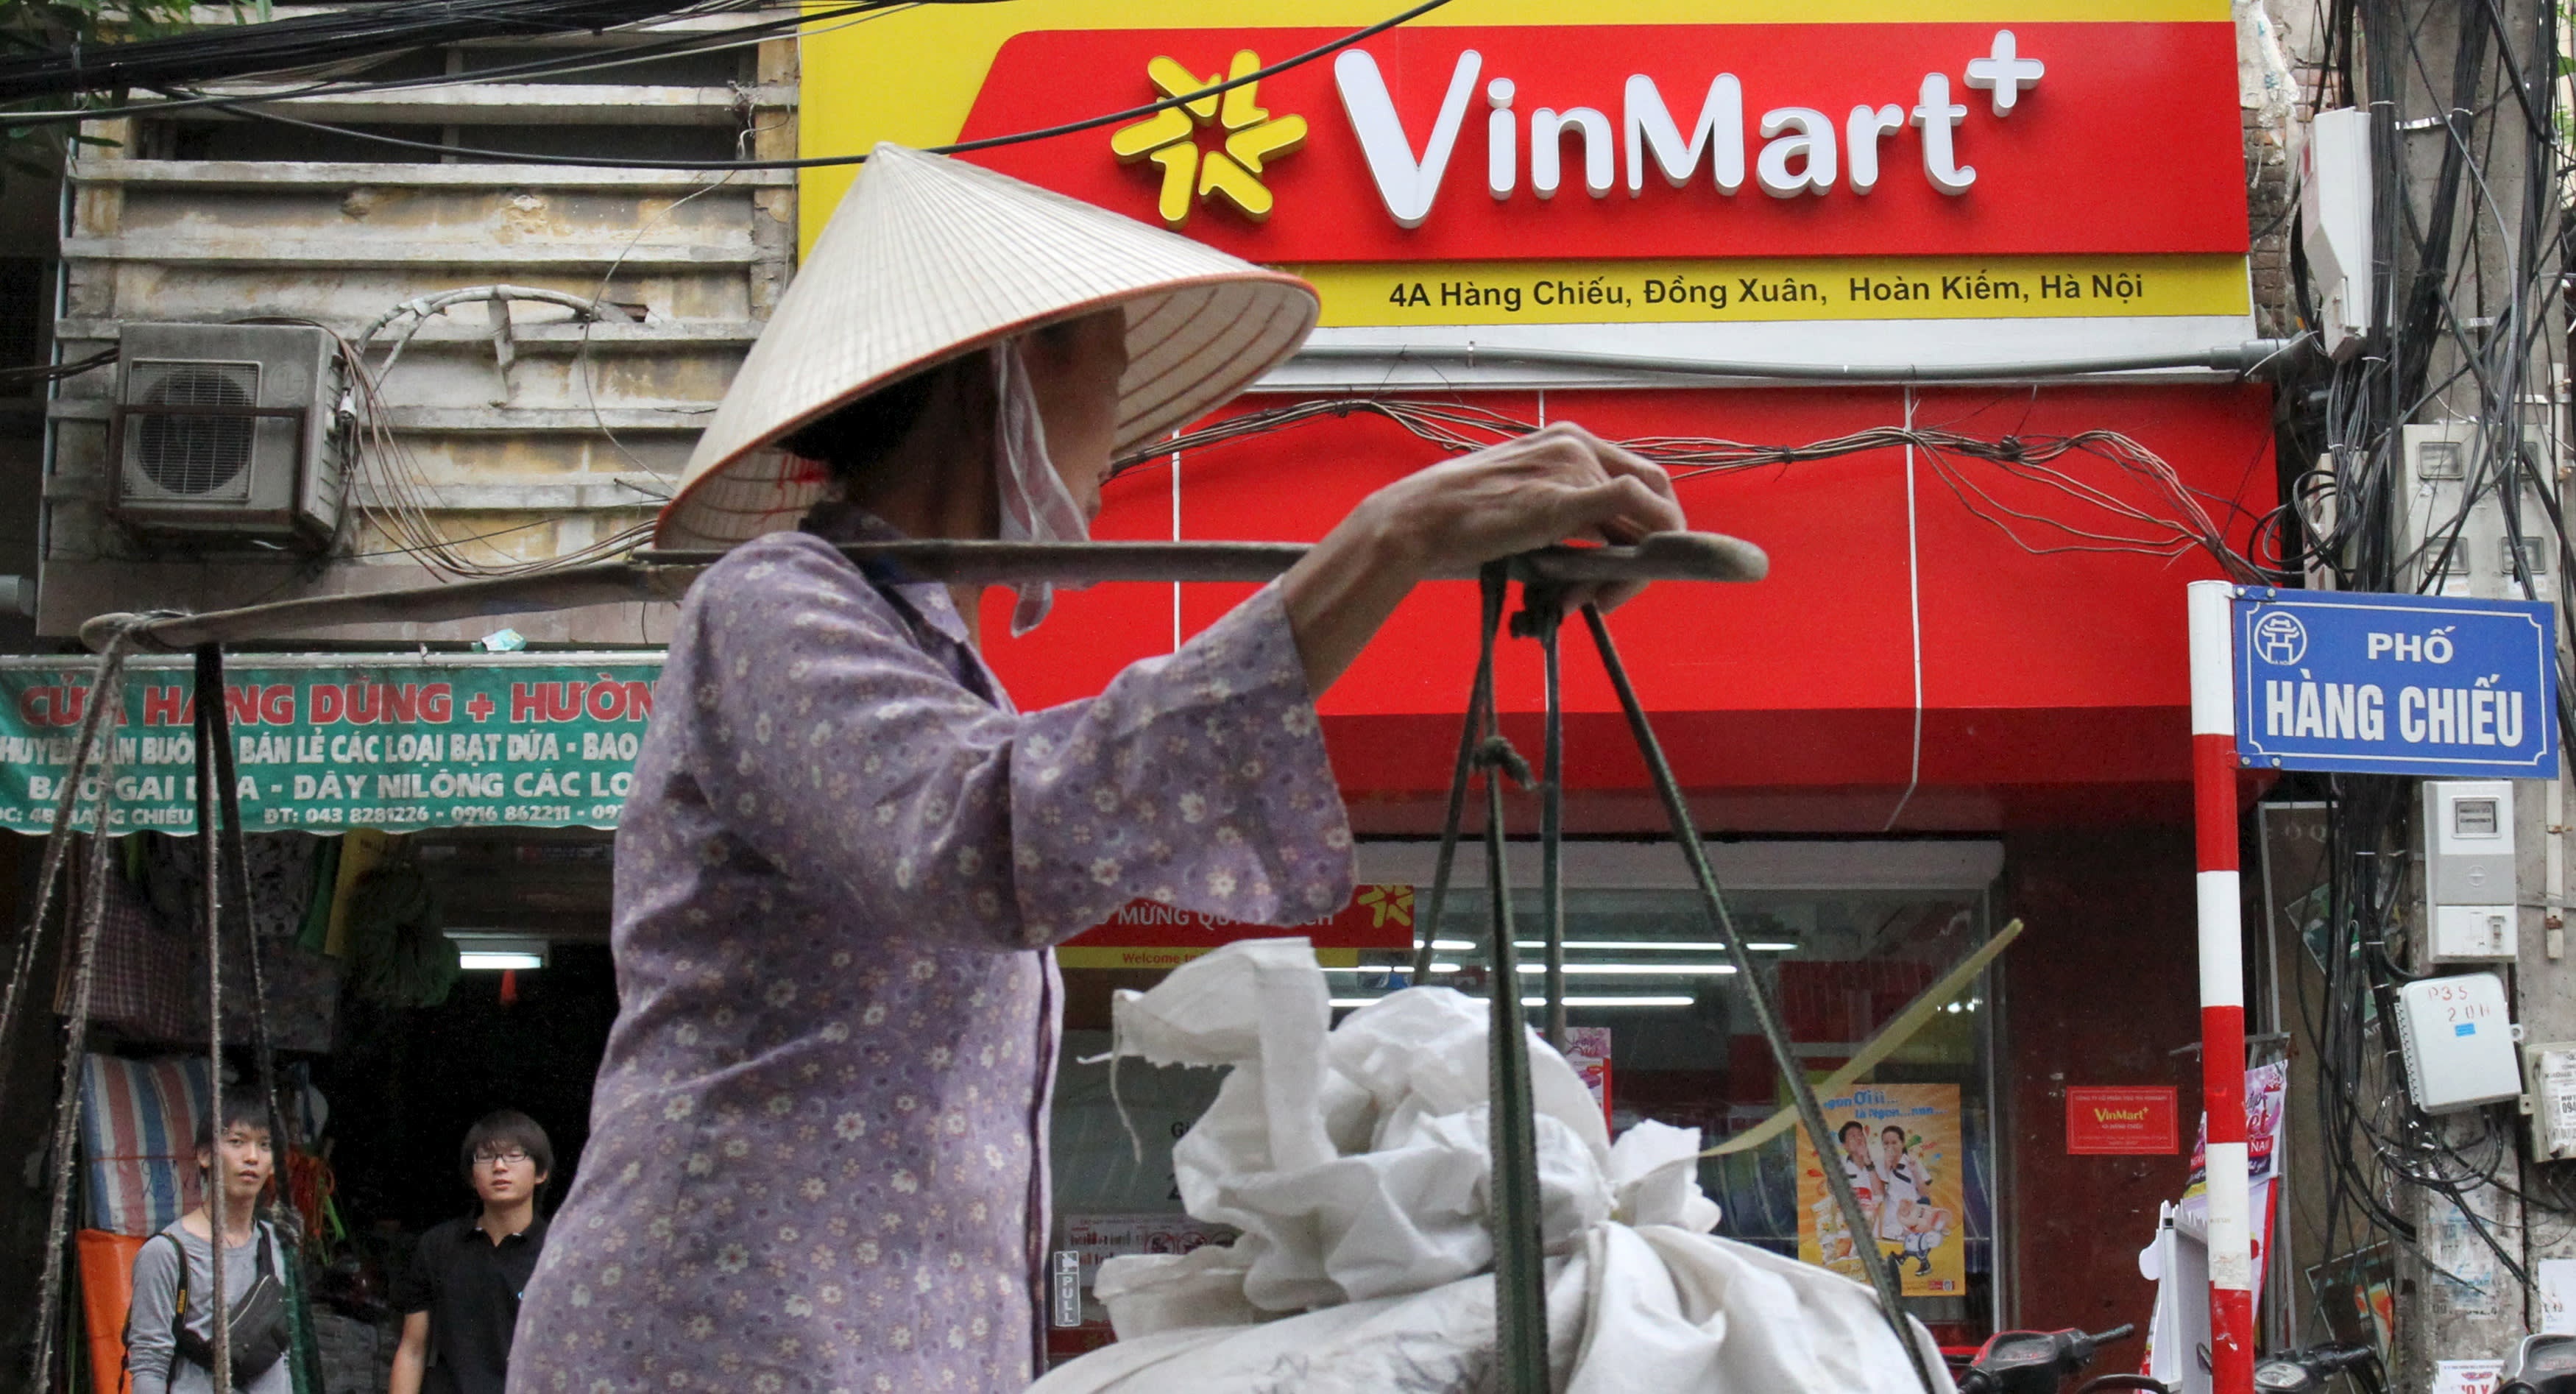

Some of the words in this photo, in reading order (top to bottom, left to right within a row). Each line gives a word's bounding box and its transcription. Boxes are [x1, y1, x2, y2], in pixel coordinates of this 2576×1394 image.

[1389, 283, 1431, 307] 4A
[1440, 280, 1522, 312] Hàng
[1533, 276, 1632, 308] Chiếu,
[1643, 275, 1727, 309] Đồng
[1738, 277, 1827, 306] Xuân,
[1849, 275, 1930, 302] Hoàn
[2041, 274, 2081, 300] Hà
[2092, 273, 2143, 305] Nội
[2367, 626, 2456, 664] PHỐ
[2265, 668, 2385, 742] HÀNG
[2398, 673, 2523, 748] CHIẾU
[142, 732, 196, 765] BUÔ
[330, 731, 380, 763] CÁC
[385, 733, 442, 767] LOẠI
[450, 733, 502, 767] BẠT
[583, 732, 638, 761] BAO
[115, 775, 174, 802] GAI
[294, 770, 367, 800] DÂY
[514, 768, 581, 798] CÁC
[305, 807, 343, 823] 043
[503, 805, 571, 821] 862211
[1122, 953, 1180, 964] Welcome
[1061, 1275, 1074, 1323] PULL
